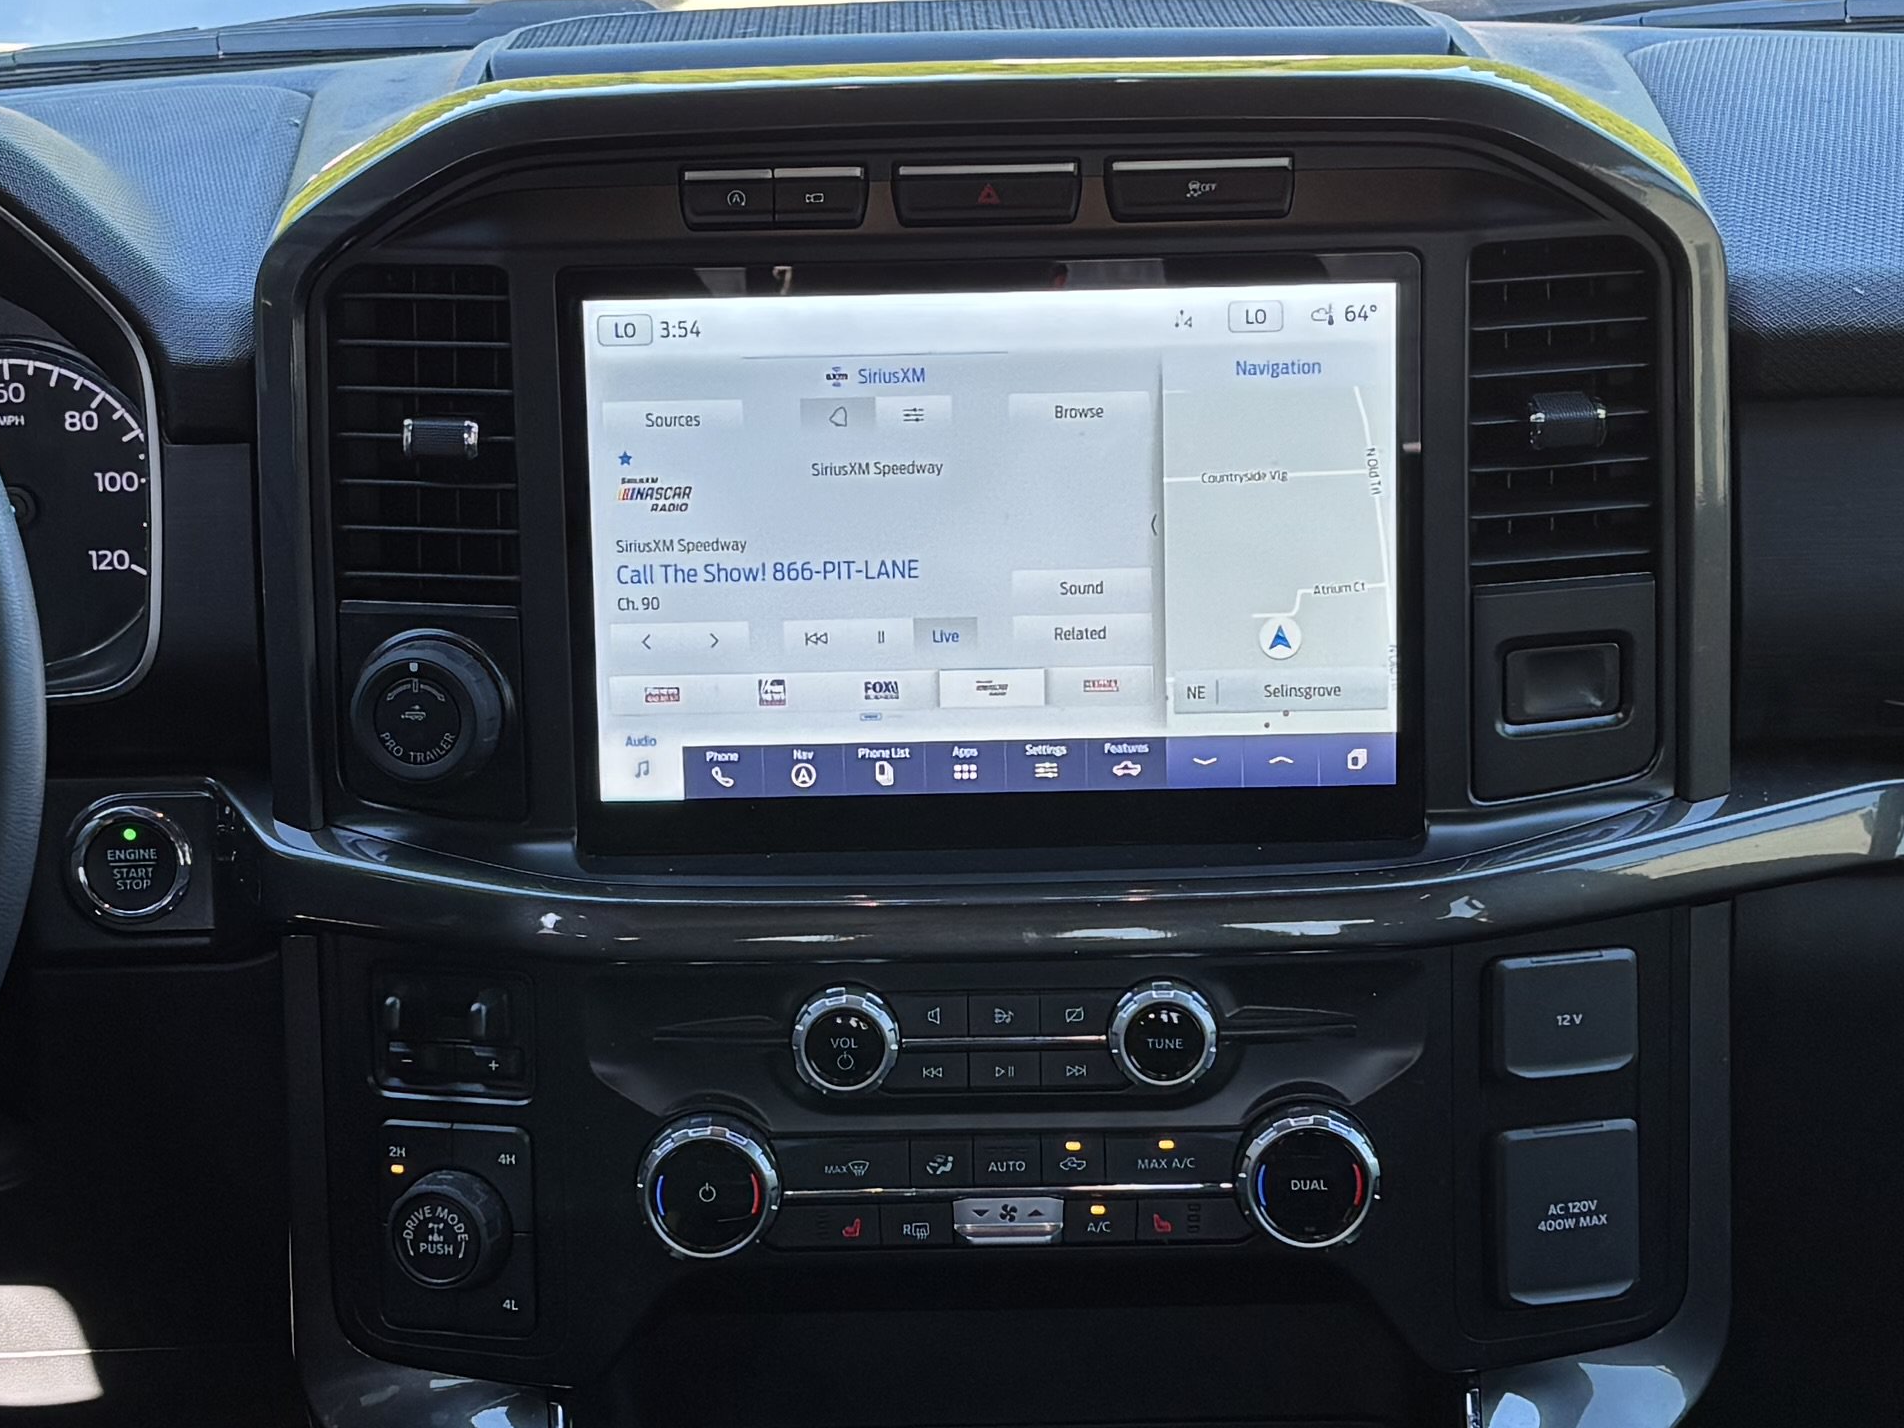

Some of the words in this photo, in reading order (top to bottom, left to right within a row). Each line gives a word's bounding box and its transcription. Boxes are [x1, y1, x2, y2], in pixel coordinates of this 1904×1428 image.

[1245, 308, 1267, 325] LO
[1344, 304, 1378, 323] 64°
[614, 322, 637, 338] LO
[659, 320, 701, 339] 3:54
[858, 367, 926, 384] SiriusXM
[1236, 359, 1322, 378] Navigation
[1054, 404, 1104, 420] Browse
[64, 410, 98, 432] 80
[645, 413, 701, 428] Sources
[810, 462, 871, 477] SiriusXM
[873, 460, 944, 478] Speedway
[94, 471, 138, 493] 100
[634, 485, 693, 501] NASCAR
[650, 502, 689, 513] RADIO
[616, 539, 674, 554] SiriusXM
[677, 537, 747, 554] Speedway
[88, 549, 130, 571] 120
[616, 564, 655, 585] Call
[660, 563, 698, 584] The
[704, 561, 767, 583] Show!
[772, 559, 920, 582] 866-PIT-LANE
[1059, 579, 1105, 596] Sound
[1313, 584, 1352, 596] Atrium
[617, 596, 639, 611] Ch.
[641, 596, 661, 611] 90
[932, 628, 960, 644] Live
[1053, 625, 1107, 642] Related
[1187, 685, 1206, 700] NE
[1264, 683, 1342, 700] Selinsgrove
[379, 731, 404, 758] PRO
[408, 731, 456, 763] TRAILER
[625, 735, 657, 748] Audio
[1104, 742, 1150, 755] Features
[706, 750, 739, 762] Phone
[793, 748, 814, 761] Nav
[858, 747, 890, 760] Phone
[891, 746, 911, 759] List
[952, 745, 978, 759] Apps
[1025, 743, 1068, 757] Settings
[106, 847, 158, 861] ENGINE
[113, 867, 154, 880] START
[116, 879, 152, 892] STOP
[1556, 1013, 1571, 1026] 12
[1573, 1012, 1584, 1025] V
[830, 1036, 859, 1050] VOL
[1146, 1035, 1185, 1052] TUNE
[388, 1145, 407, 1159] 2H
[497, 1153, 516, 1167] 4H
[988, 1160, 1026, 1173] AUTO
[1137, 1157, 1168, 1170] MAX
[1172, 1156, 1196, 1169] A/C
[824, 1164, 848, 1175] MAX
[1290, 1179, 1328, 1192] DUAL
[1548, 1202, 1566, 1216] AC
[1568, 1199, 1598, 1214] 120V
[403, 1205, 433, 1240] DRIVE
[435, 1205, 469, 1243] MODE
[1086, 1220, 1112, 1233] A/C
[1537, 1218, 1576, 1233] 400W
[1579, 1213, 1608, 1228] MAX
[419, 1241, 454, 1256] PUSH
[502, 1298, 519, 1311] 4L
